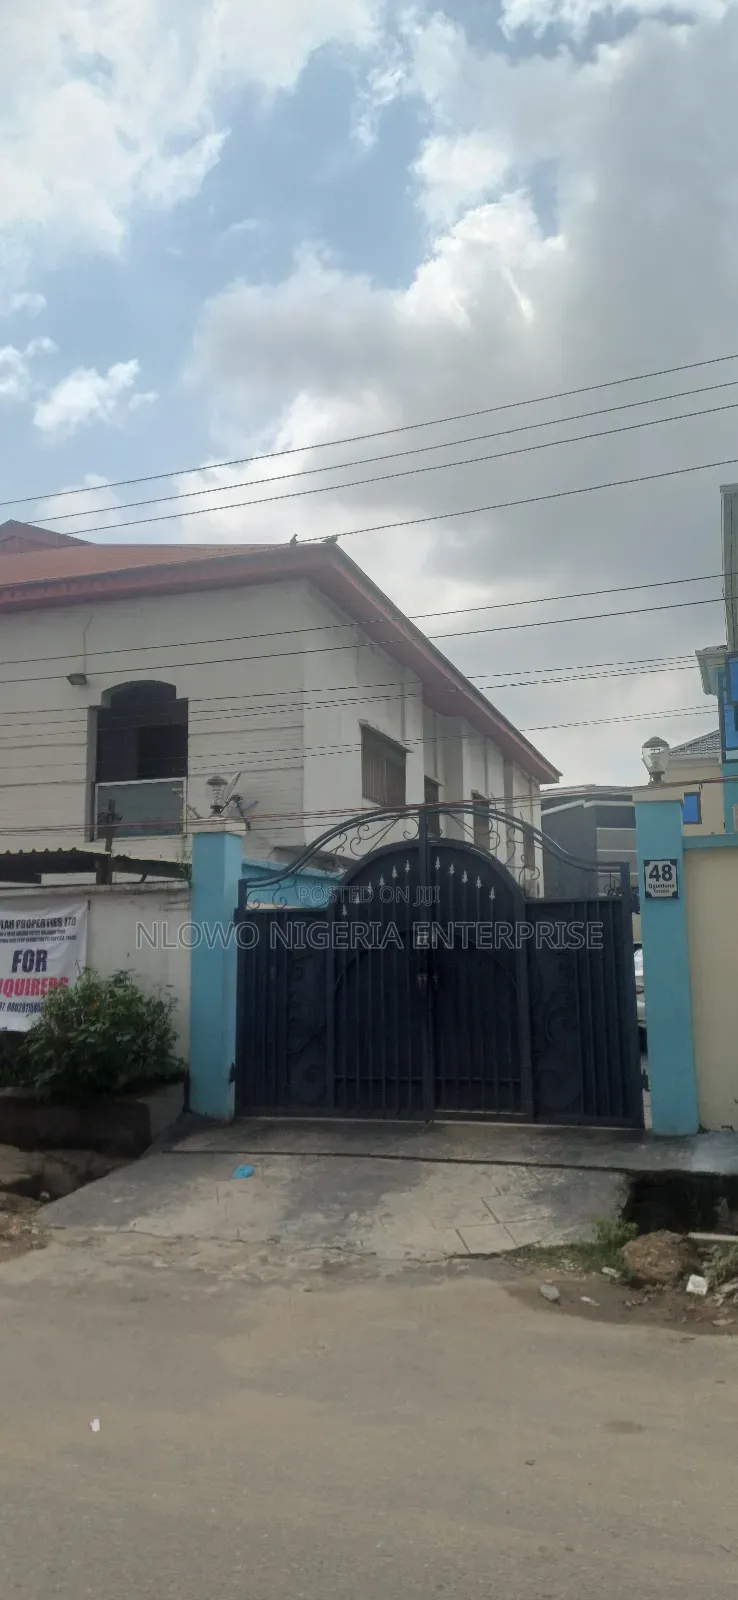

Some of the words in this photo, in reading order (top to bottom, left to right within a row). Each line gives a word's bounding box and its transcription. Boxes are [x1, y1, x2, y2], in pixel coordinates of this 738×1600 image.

[648, 864, 673, 882] 48
[16, 917, 63, 929] PROPERTIES
[11, 949, 48, 973] FOR
